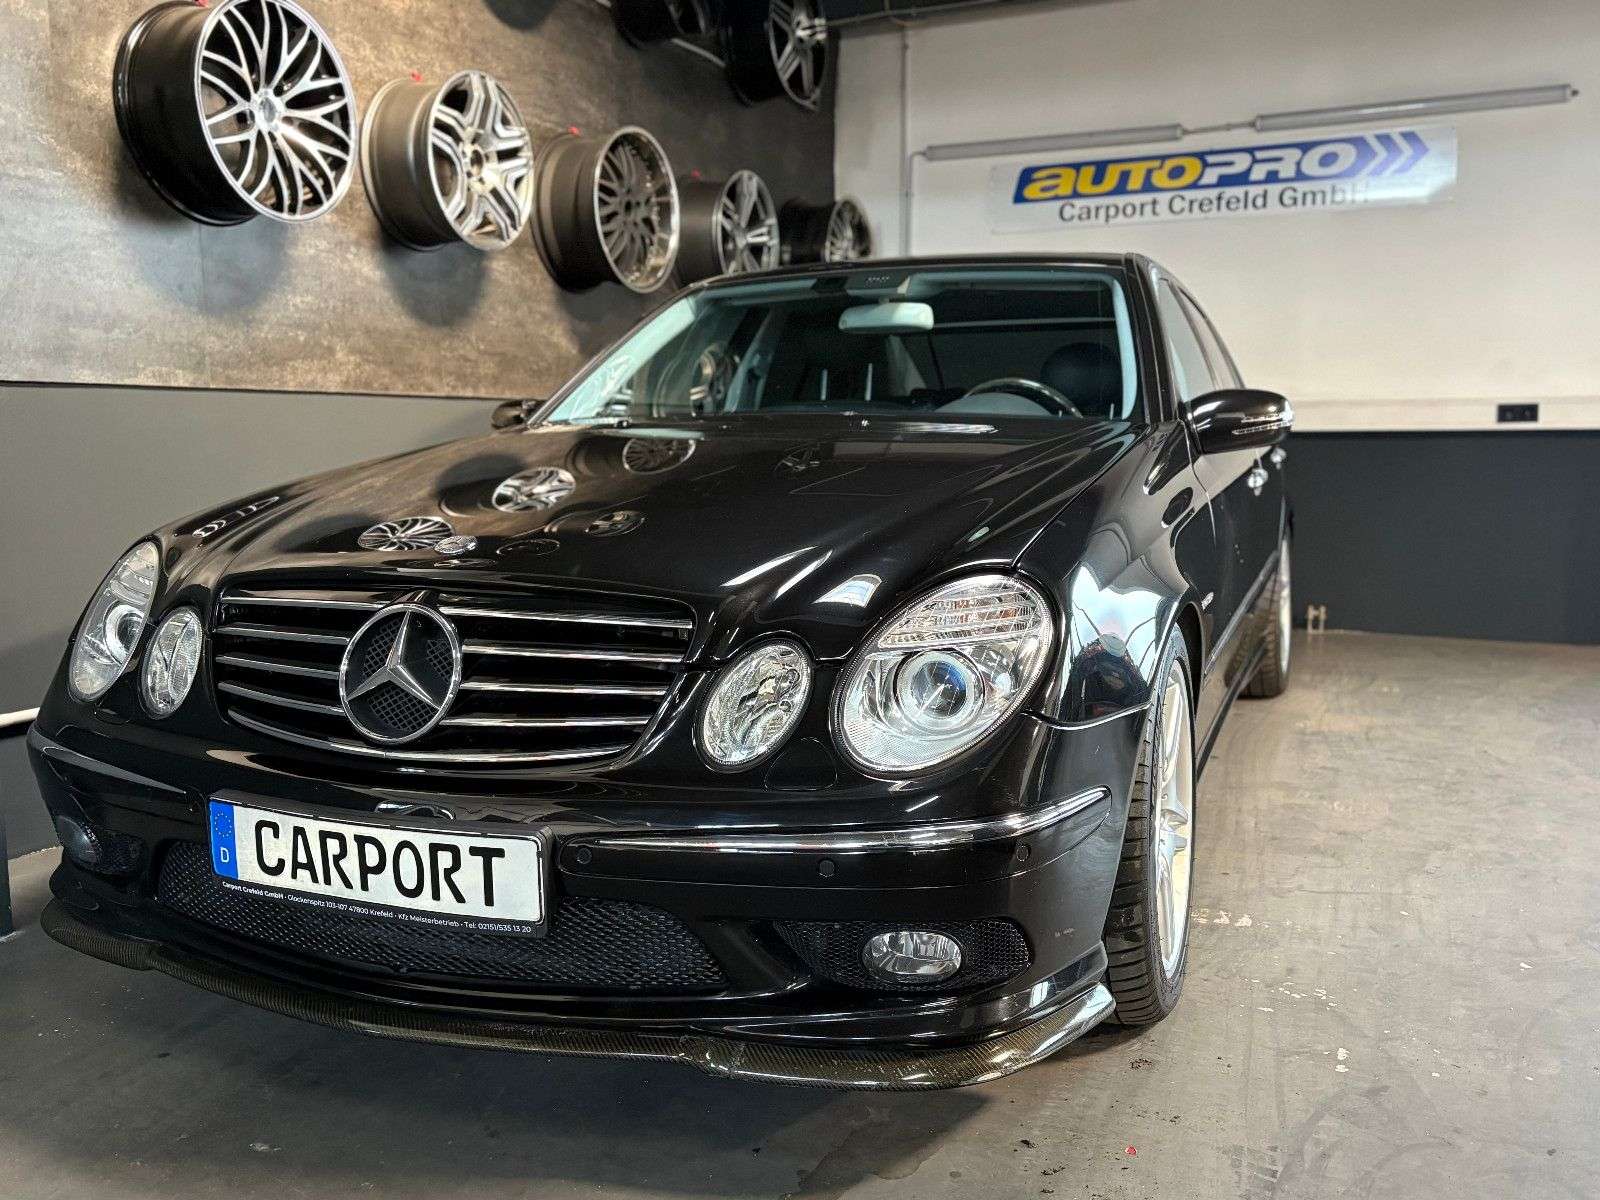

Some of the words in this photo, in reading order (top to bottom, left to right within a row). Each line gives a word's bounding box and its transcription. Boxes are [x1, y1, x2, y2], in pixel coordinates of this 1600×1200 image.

[1058, 198, 1160, 223] Carport
[1168, 189, 1268, 215] Crefeld
[1279, 179, 1369, 208] GmbH
[219, 846, 230, 863] D
[254, 819, 506, 907] CARPORT
[222, 881, 242, 891] Carport
[243, 886, 263, 896] Crefeld
[264, 891, 283, 899] GmbH
[287, 894, 325, 907] Glockenspitz
[325, 901, 347, 911] 103-107
[369, 909, 393, 918] Krefeld
[409, 914, 459, 927] Meisterbetrieb
[478, 923, 512, 932] 02151/535
[522, 925, 532, 933] 20
